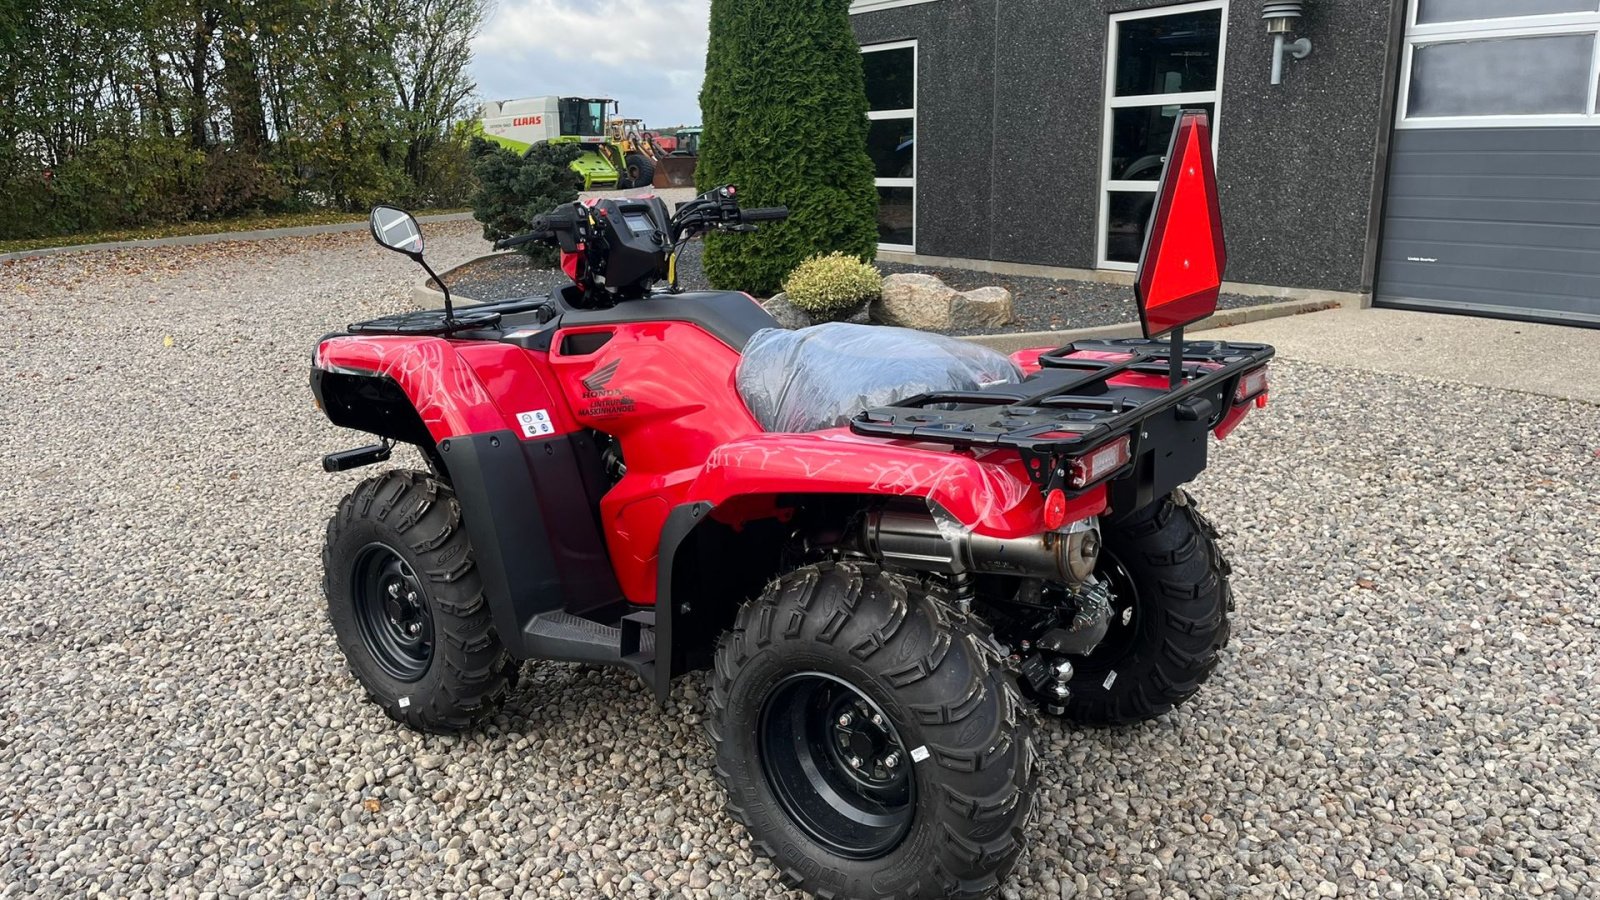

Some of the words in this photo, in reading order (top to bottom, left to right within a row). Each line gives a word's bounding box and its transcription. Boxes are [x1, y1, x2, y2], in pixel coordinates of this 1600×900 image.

[513, 116, 541, 126] CLAAS
[582, 389, 621, 398] HONDA
[578, 405, 635, 416] MASKINHANDEL
